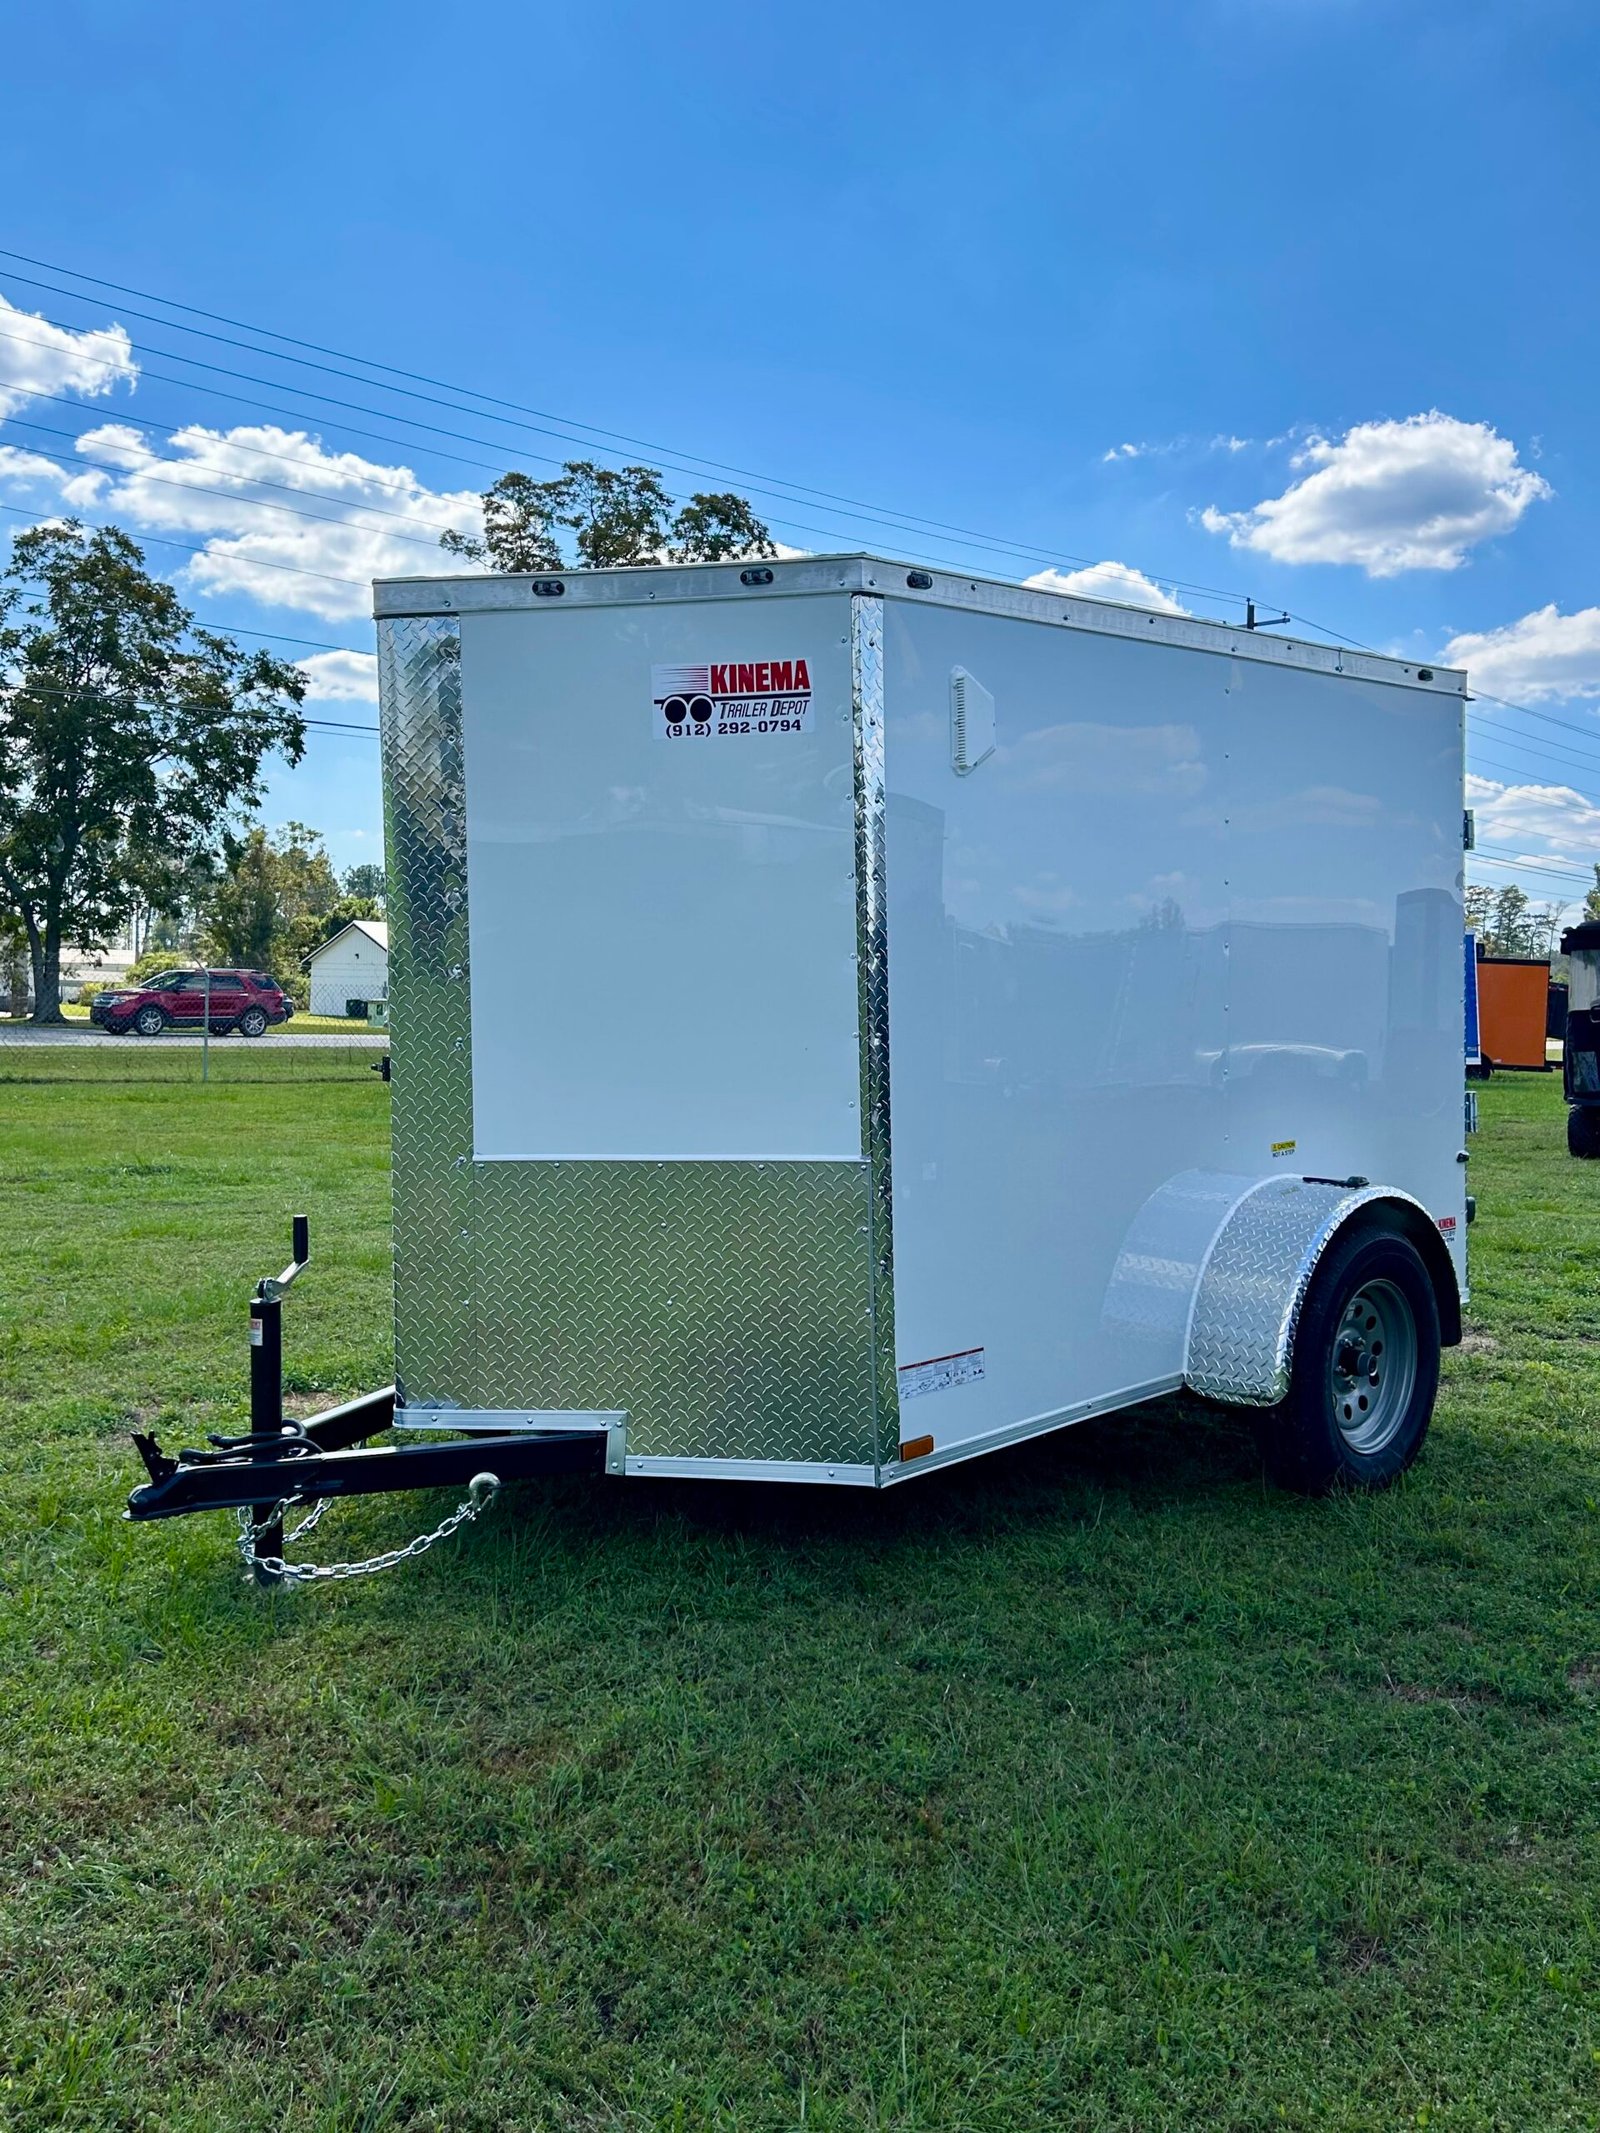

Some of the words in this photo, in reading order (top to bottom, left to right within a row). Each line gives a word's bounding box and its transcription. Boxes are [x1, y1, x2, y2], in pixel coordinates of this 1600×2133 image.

[710, 660, 810, 694] KINEMA
[719, 701, 768, 720] TRAILER
[770, 700, 810, 717] DEPOT
[666, 723, 711, 739] (912)
[718, 720, 801, 735] 292-0794
